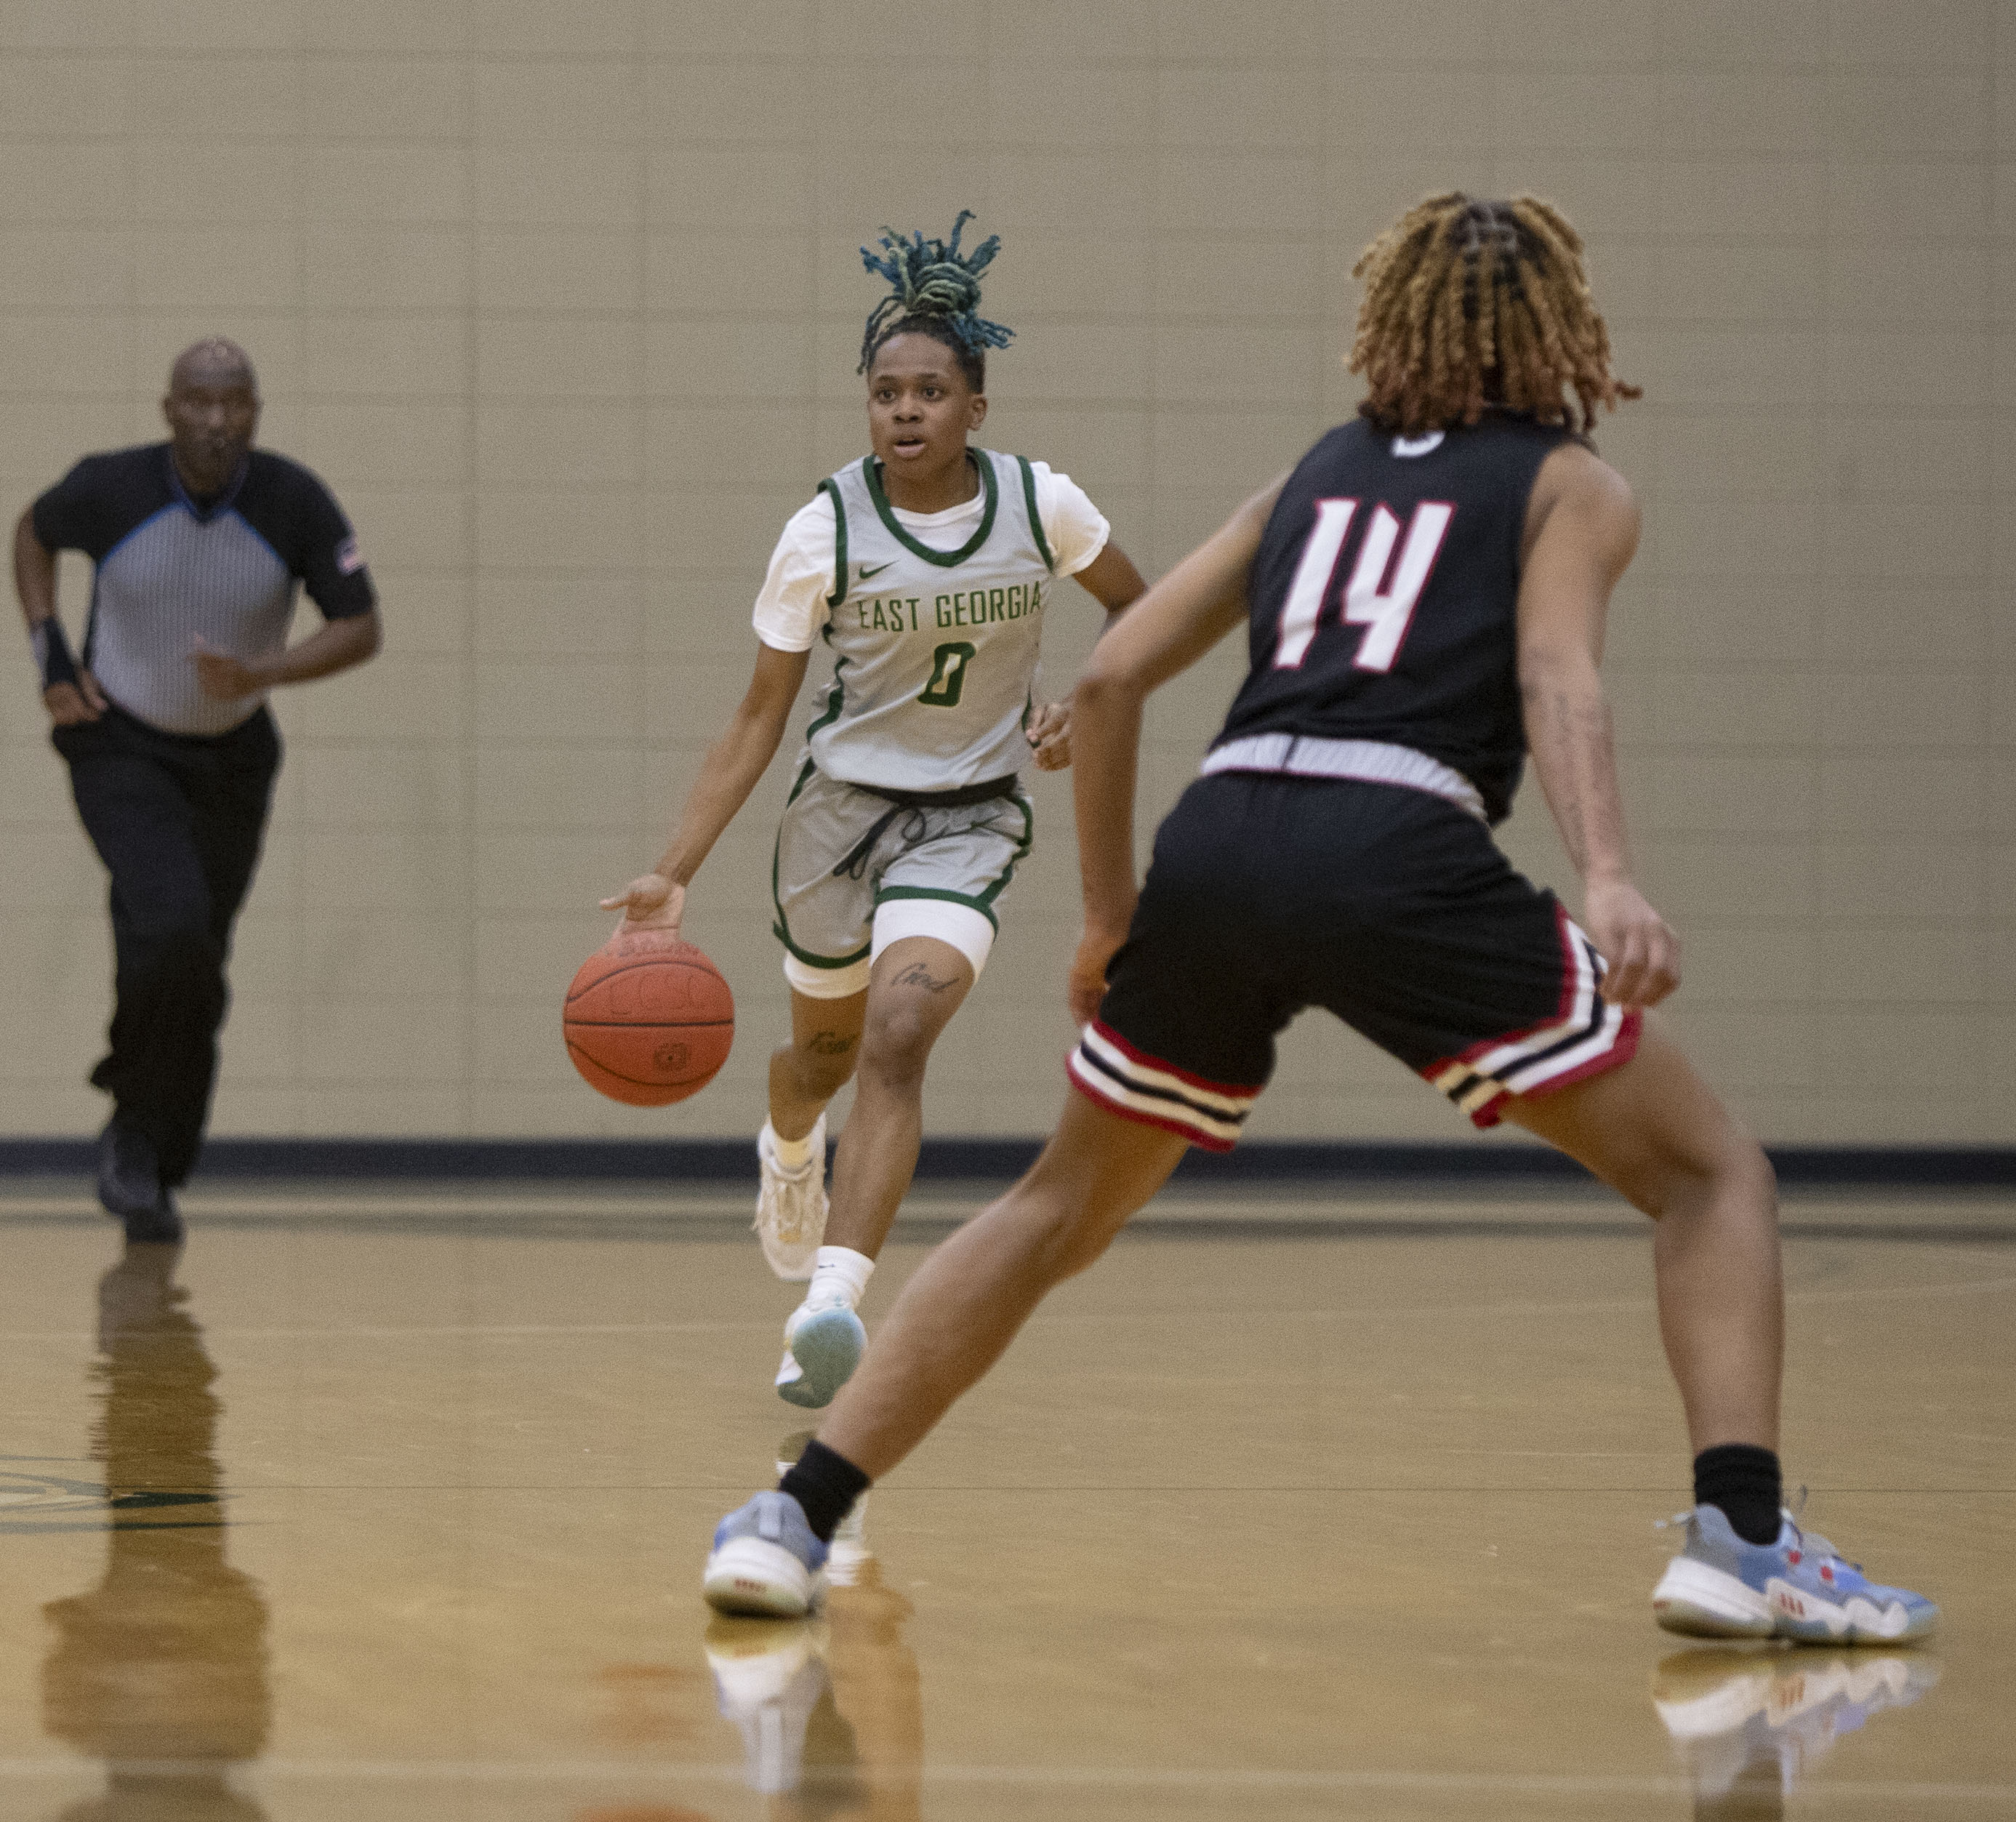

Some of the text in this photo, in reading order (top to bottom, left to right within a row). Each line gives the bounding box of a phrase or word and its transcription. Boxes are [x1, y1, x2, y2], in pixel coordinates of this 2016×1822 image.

[857, 580, 1041, 632] EAST GEORGIA
[1273, 497, 1457, 673] 14
[917, 641, 976, 707] 0
